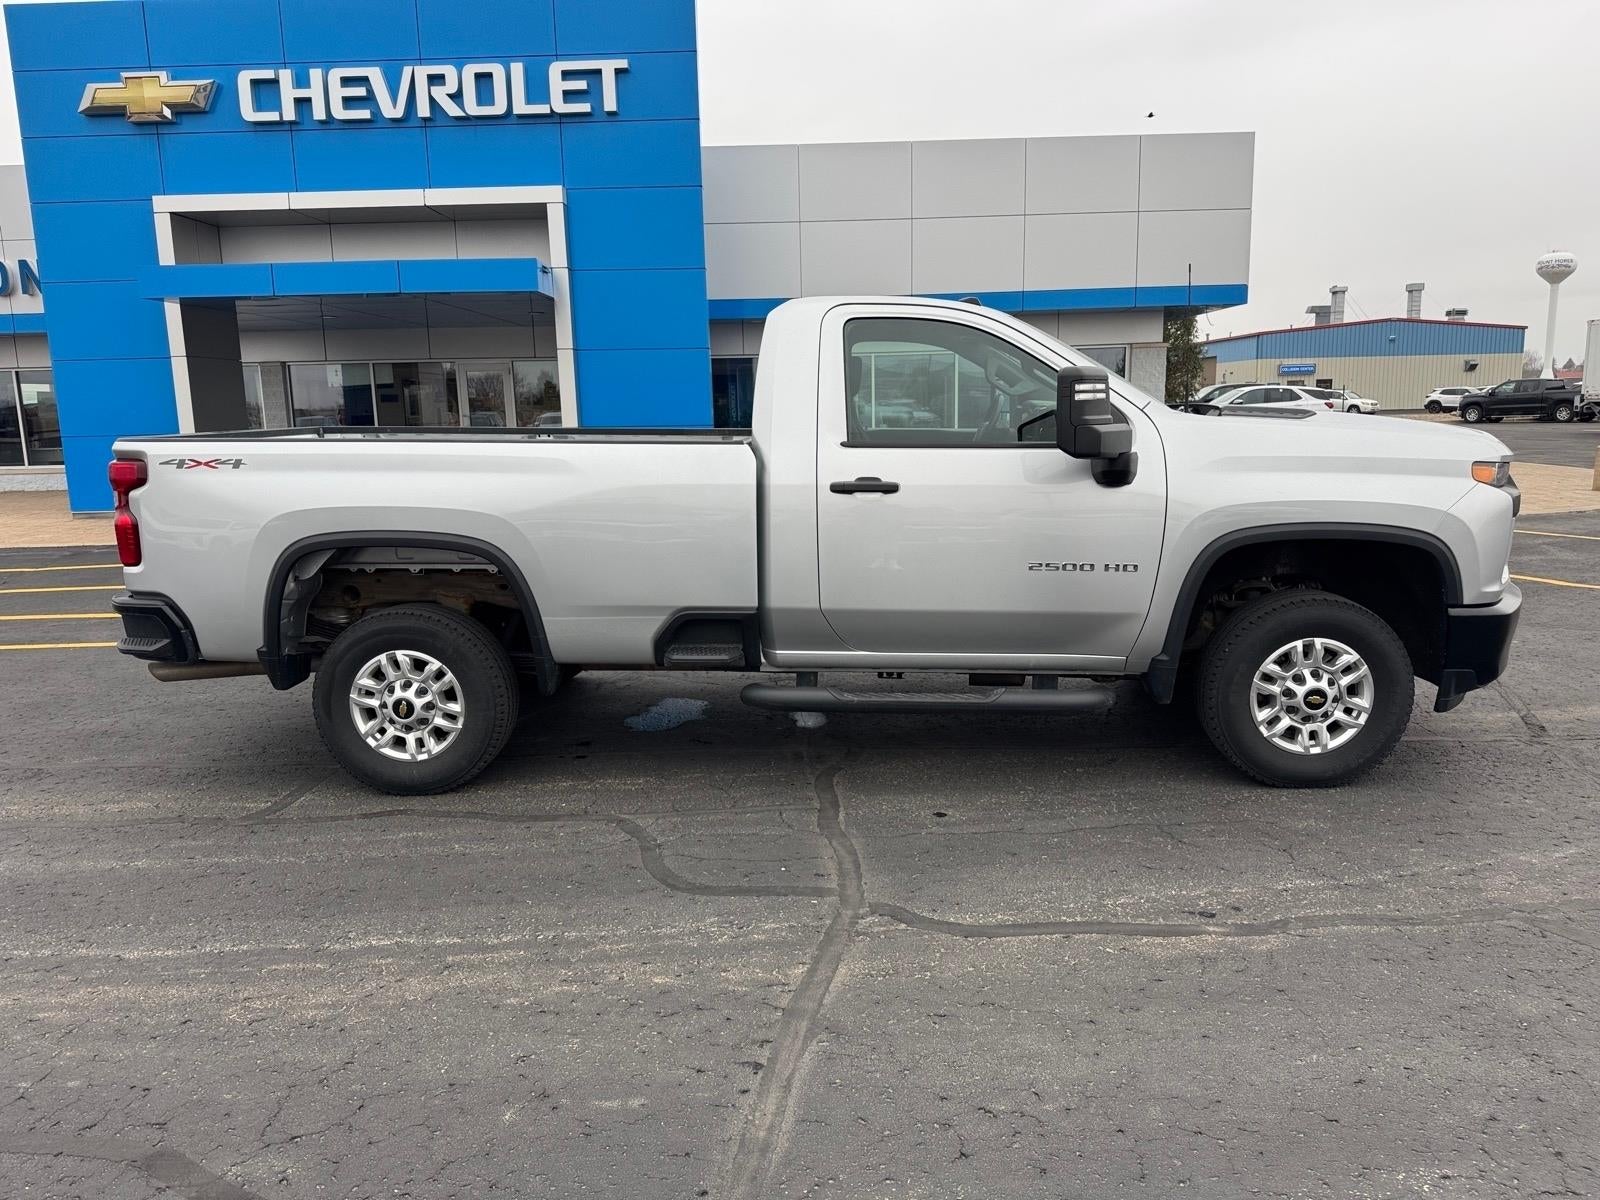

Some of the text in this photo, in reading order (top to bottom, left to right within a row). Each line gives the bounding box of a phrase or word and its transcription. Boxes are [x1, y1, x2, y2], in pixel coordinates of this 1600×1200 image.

[237, 58, 630, 123] CHEVROLET
[1027, 562, 1139, 573] 2500 HD
